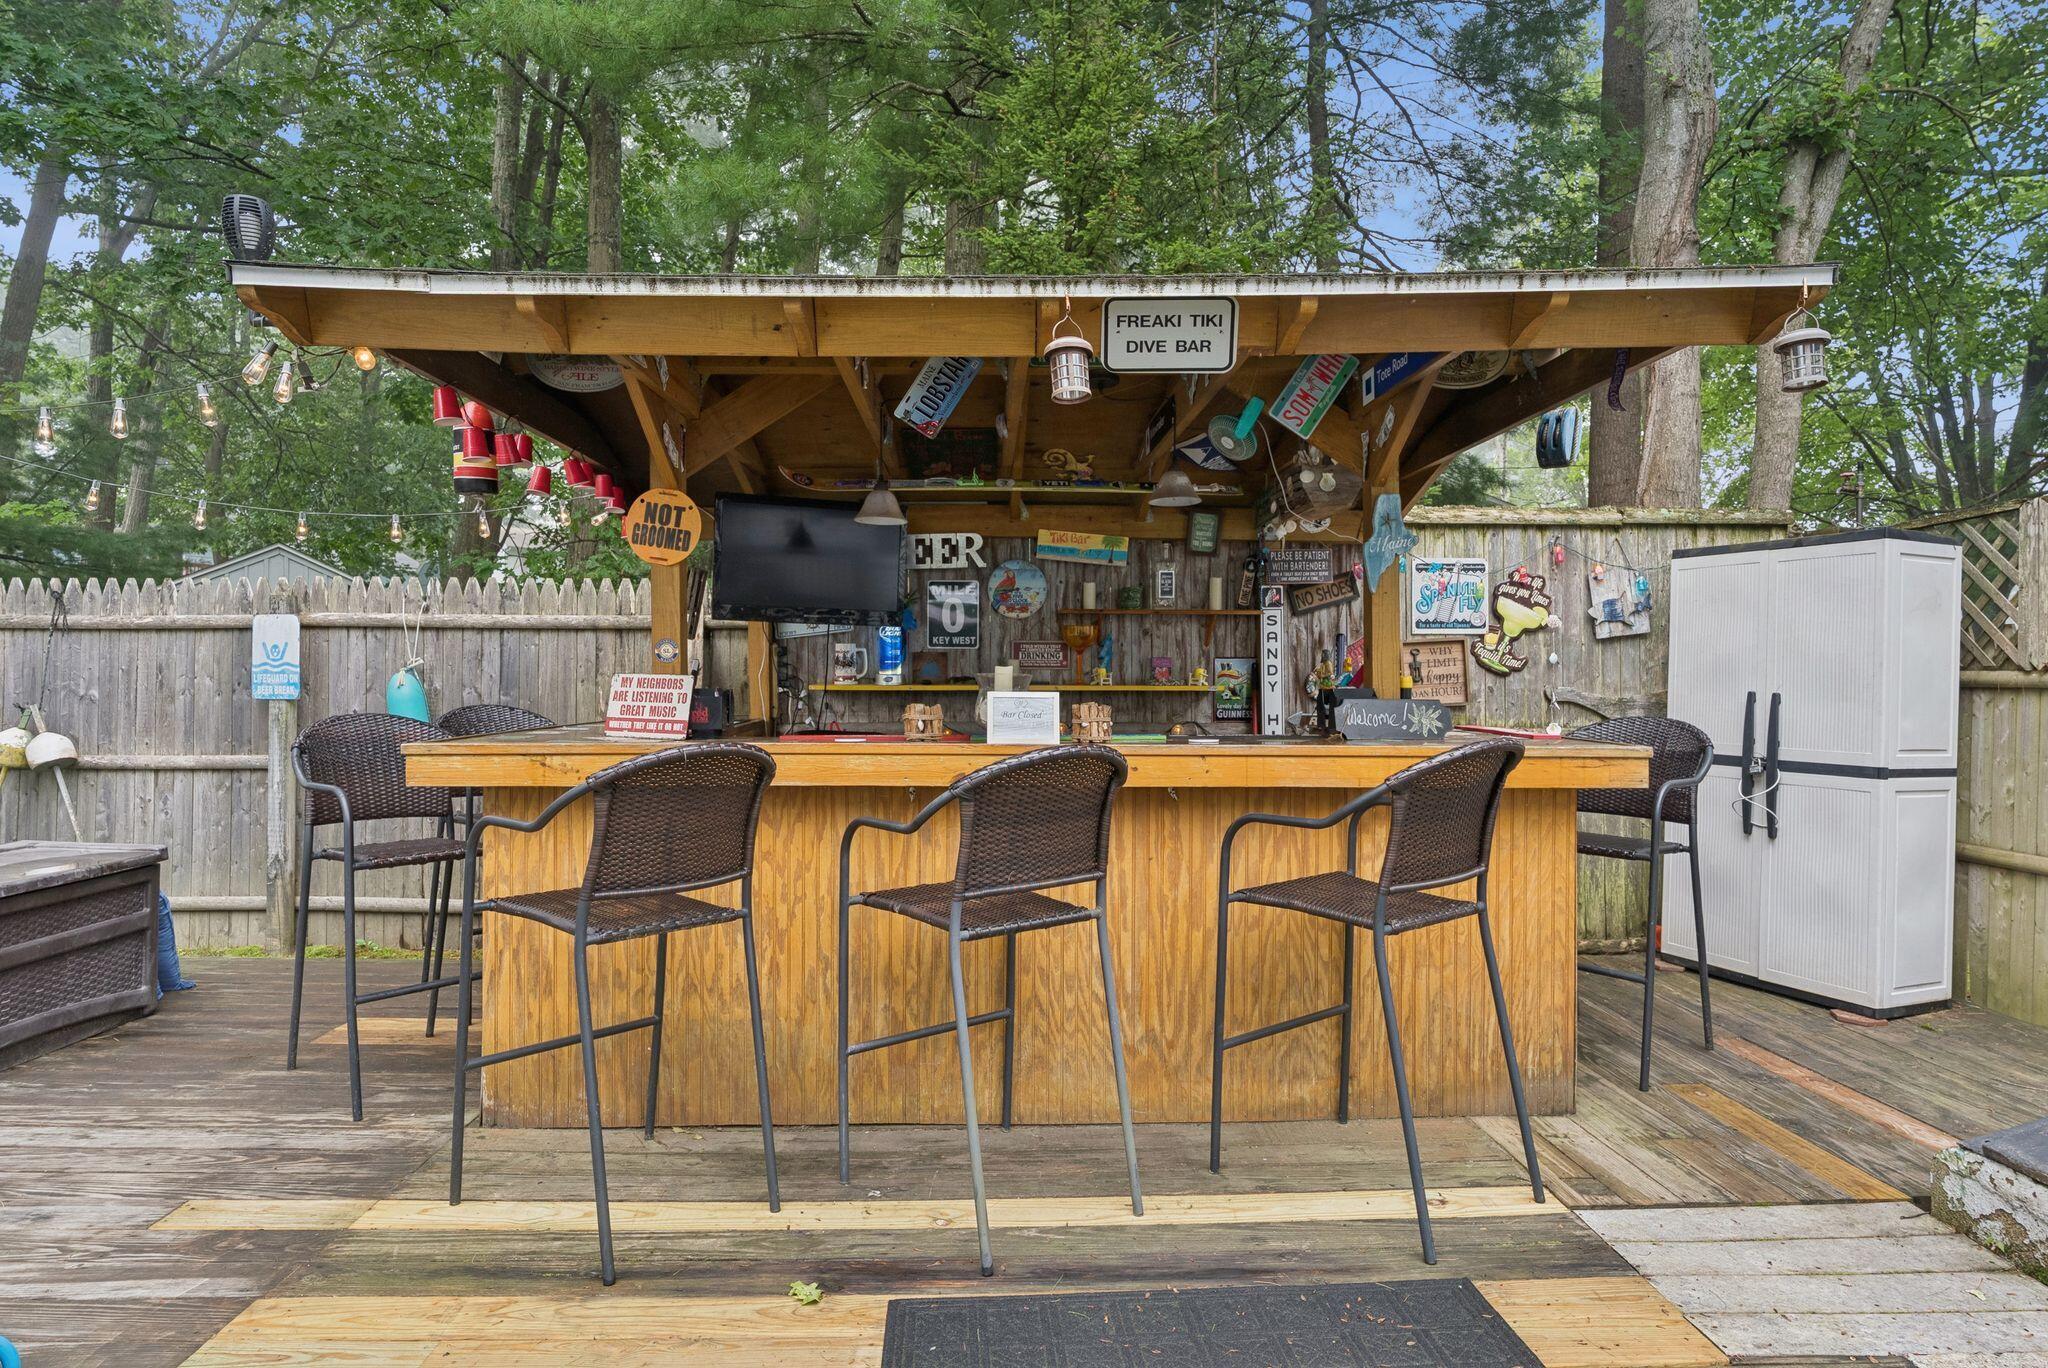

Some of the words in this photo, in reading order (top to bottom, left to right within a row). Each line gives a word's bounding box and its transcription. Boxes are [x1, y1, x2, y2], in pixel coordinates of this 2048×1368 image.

[1116, 314, 1181, 328] FREAKI
[1190, 314, 1223, 328] TIKI
[1126, 340, 1167, 353] DIVE
[1175, 340, 1212, 353] BAR
[1377, 366, 1391, 384] Tote
[1392, 352, 1408, 374] Road
[561, 372, 600, 381] ALE
[917, 364, 937, 389] MAINE
[1283, 387, 1320, 427] SOM
[644, 501, 687, 528] NOT
[631, 522, 692, 552] GROOMED
[1369, 534, 1414, 553] Maine
[906, 532, 987, 569] EER
[1270, 551, 1293, 560] PLEASE
[1294, 551, 1303, 560] BE
[1304, 551, 1329, 560] PATIENT
[1272, 562, 1289, 571] WITH
[1290, 561, 1329, 571] BARTENDER!
[1244, 575, 1253, 590] PINE
[1512, 571, 1531, 584] Wn
[1532, 575, 1544, 589] life
[929, 583, 977, 596] MILE
[1240, 588, 1250, 604] LONE
[1295, 590, 1314, 609] NO
[1316, 578, 1353, 601] SHOES
[1498, 583, 1518, 594] gives
[1516, 586, 1531, 598] you
[1530, 589, 1550, 606] Limes
[1459, 595, 1484, 613] FLY
[941, 597, 965, 633] 0
[932, 636, 950, 644] KEY
[951, 636, 976, 644] WEST
[1497, 640, 1511, 653] it's
[1021, 652, 1061, 660] DRINKING
[1266, 615, 1278, 692] SANDY
[1428, 646, 1454, 655] WHY
[1427, 657, 1458, 668] LIMIT
[1501, 654, 1526, 668] Time!
[253, 673, 288, 683] LIFEGUARD
[288, 673, 298, 682] ON
[620, 676, 634, 688] MY
[636, 677, 684, 690] NEIGHBORS
[1427, 669, 1459, 684] happy
[257, 685, 274, 695] BEER
[274, 685, 295, 695] BREAK
[613, 690, 628, 702] ARE
[631, 691, 673, 704] LISTENING
[677, 692, 688, 704] TO
[1431, 686, 1463, 697] HOUR?
[620, 704, 646, 716] GREAT
[648, 705, 677, 718] MUSIC
[1000, 710, 1017, 719] Bar
[1018, 709, 1043, 719] Closed
[1343, 702, 1409, 730] Welcome!
[609, 720, 633, 729] WHETHER
[633, 721, 644, 730] THEY
[647, 722, 657, 730] LIKE
[658, 722, 664, 730] IT
[664, 722, 672, 731] OR
